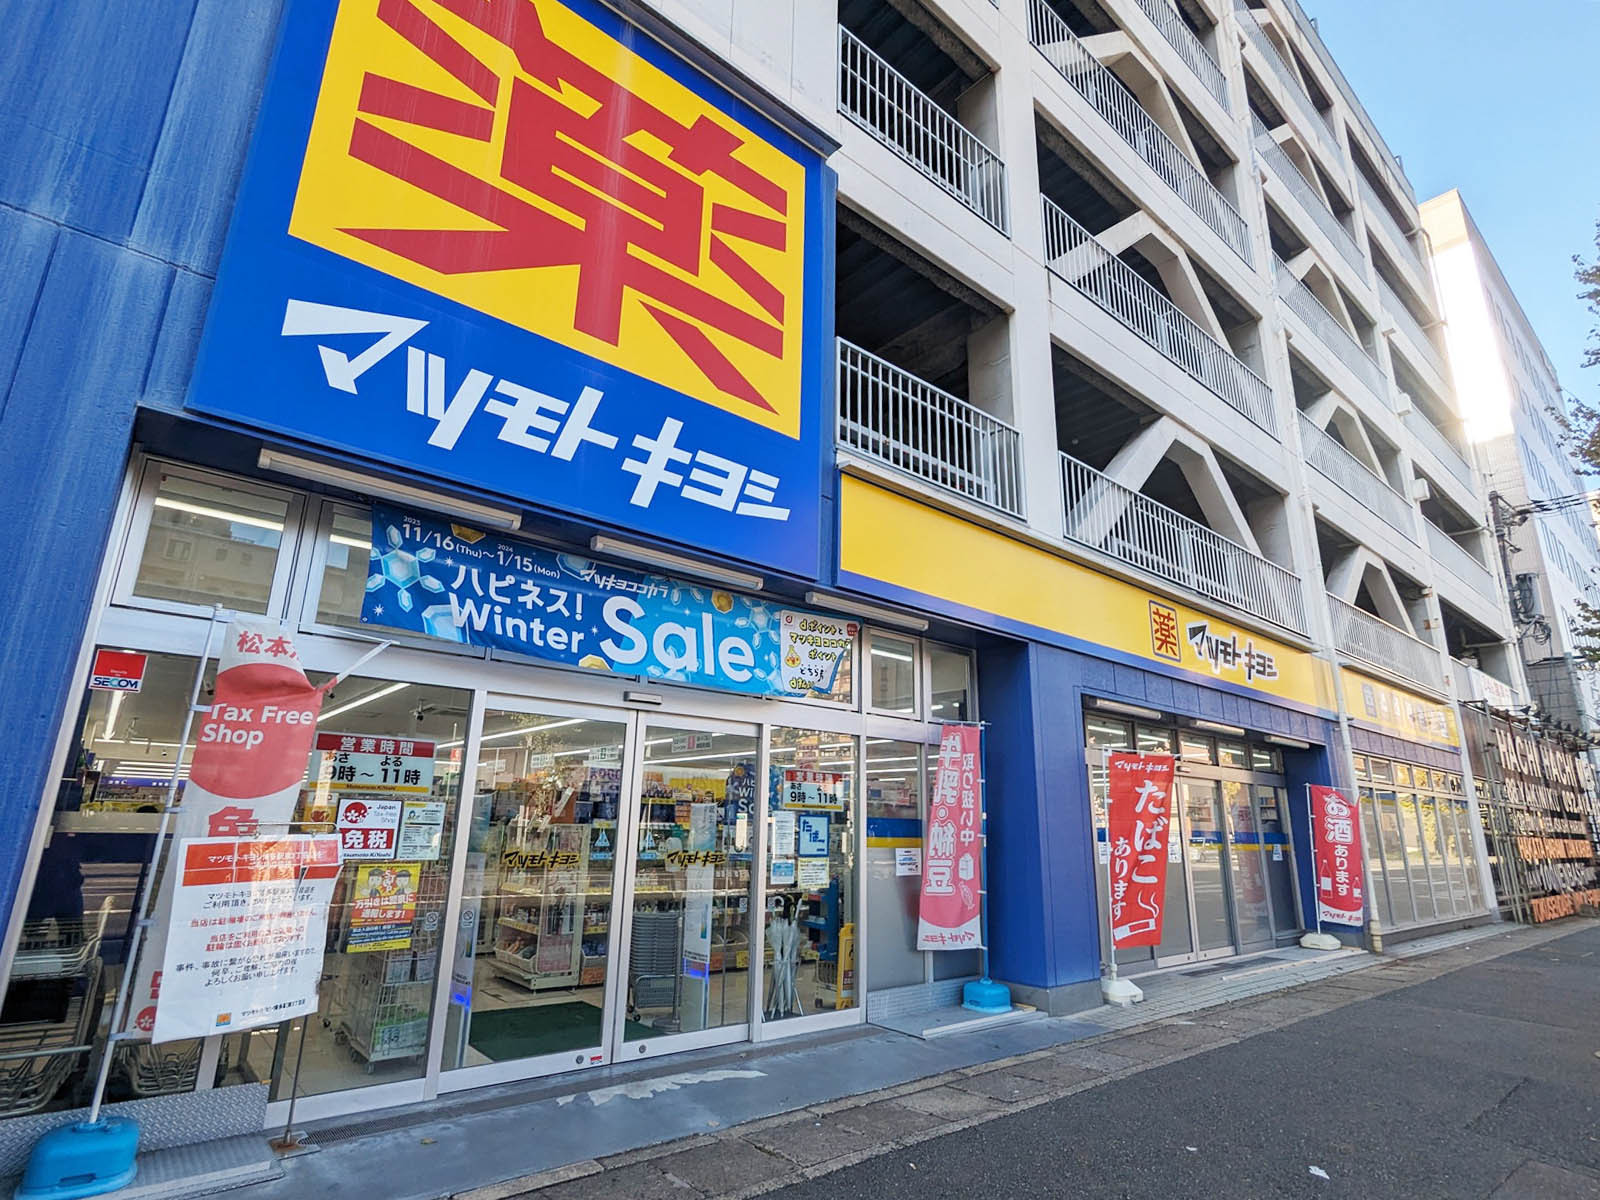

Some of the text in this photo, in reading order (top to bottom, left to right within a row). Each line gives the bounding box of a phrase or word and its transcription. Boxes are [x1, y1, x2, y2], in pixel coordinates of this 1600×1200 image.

[334, 0, 787, 416] 薬
[281, 299, 790, 521] マツモトキヨシ
[580, 564, 669, 599] マツキヨココカラ
[449, 591, 755, 683] Winter Sale
[1152, 607, 1279, 681] 薬 マツモトキヨシ
[93, 676, 139, 689] SECOM
[210, 703, 314, 725] Tax Free
[201, 723, 264, 750] Shop
[340, 736, 415, 755] 営業時間
[380, 755, 402, 767] よる
[1114, 760, 1170, 773] マツモトキヨシ
[344, 829, 388, 849] 免税
[1131, 779, 1168, 884] たばこ
[504, 851, 580, 868] マツモトキヨシ
[666, 850, 726, 867] マツモトキヨシ
[1112, 836, 1132, 921] あります
